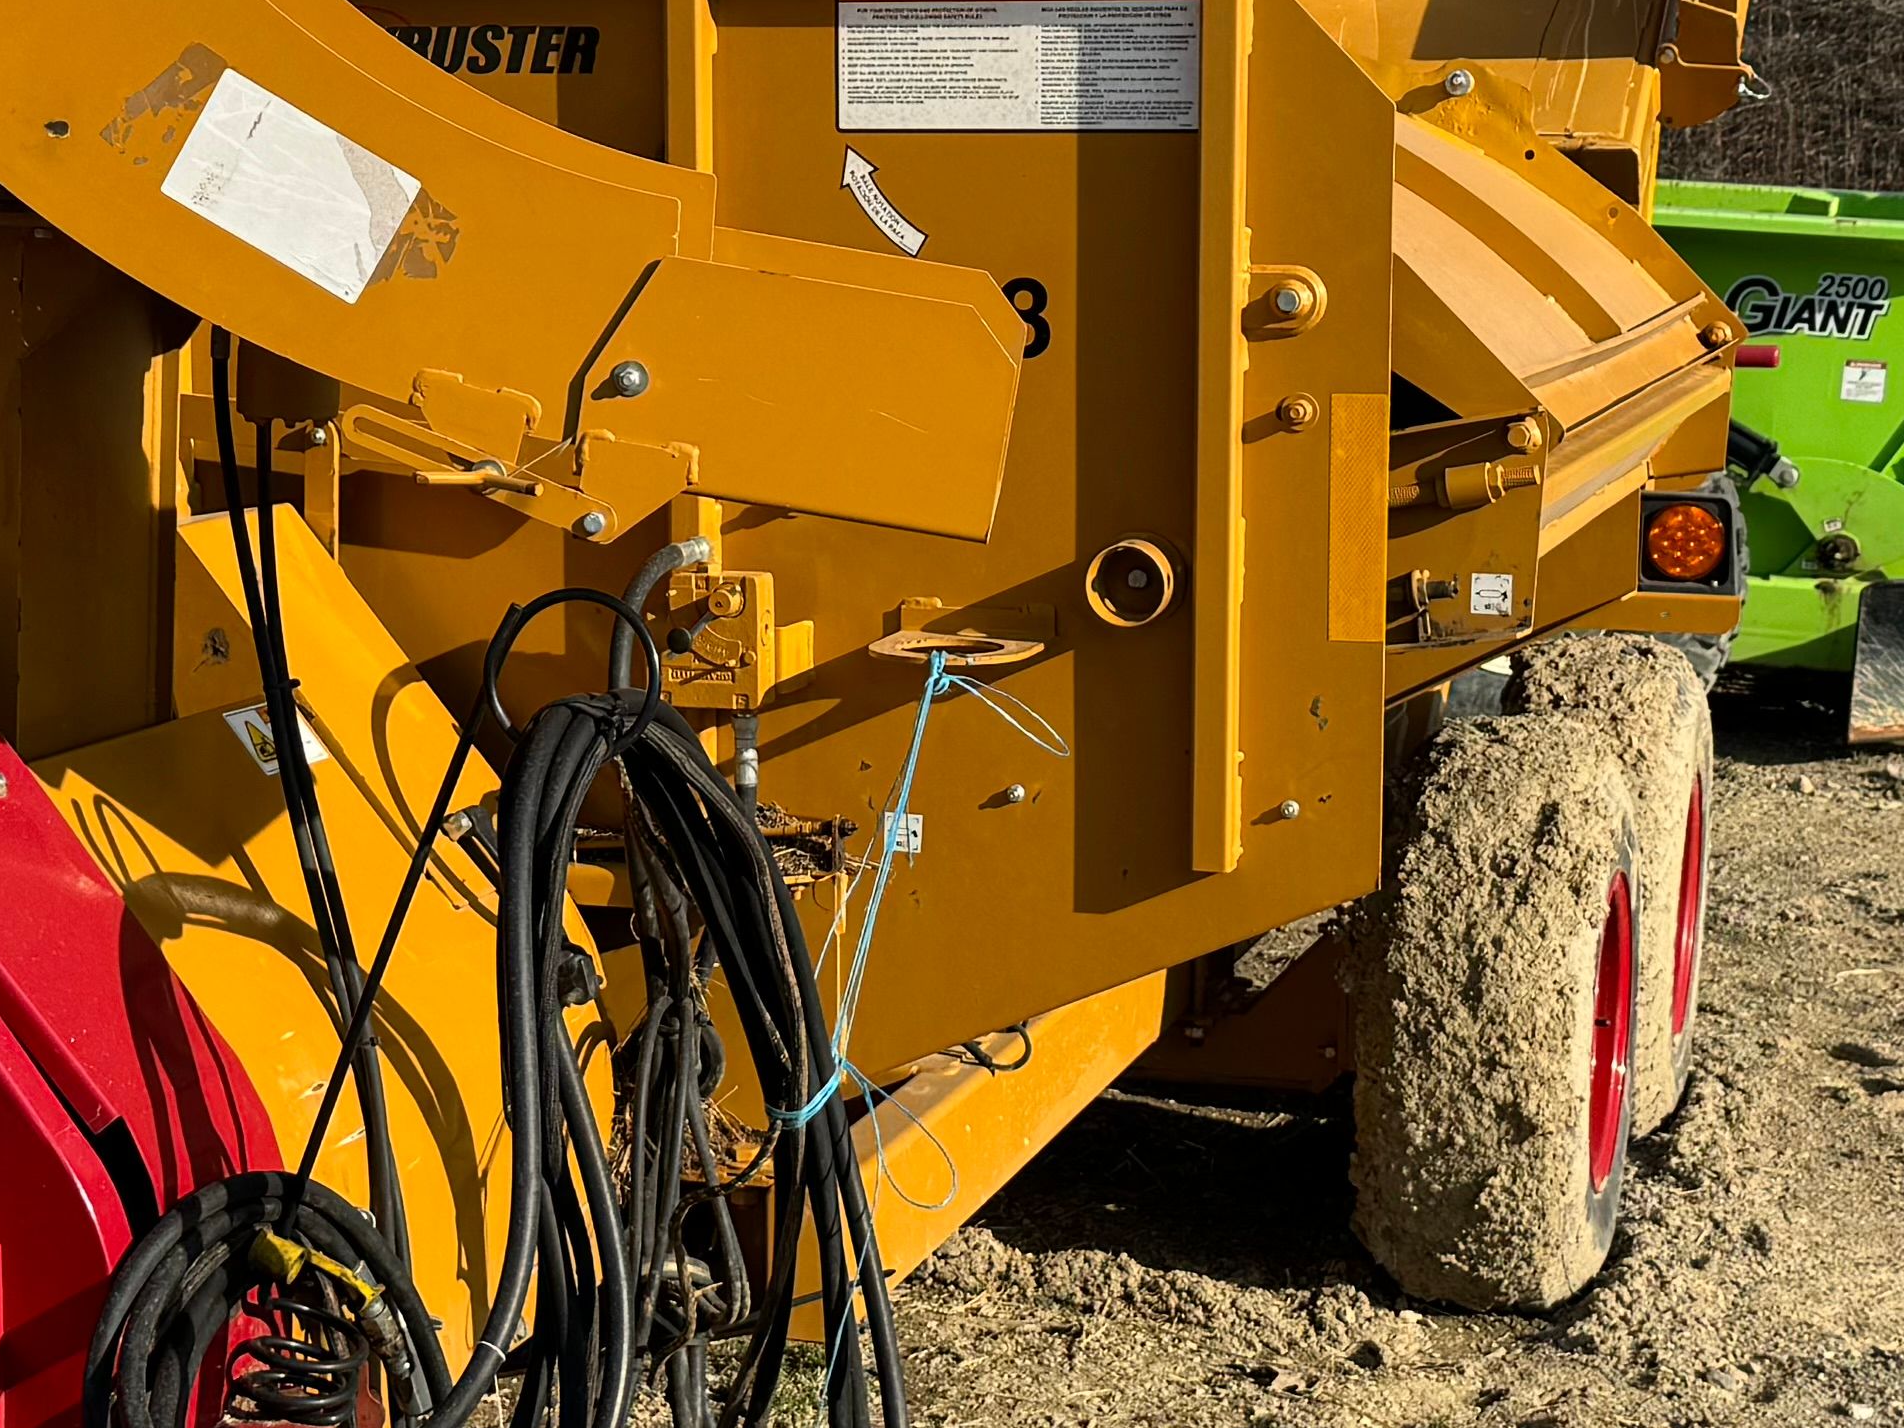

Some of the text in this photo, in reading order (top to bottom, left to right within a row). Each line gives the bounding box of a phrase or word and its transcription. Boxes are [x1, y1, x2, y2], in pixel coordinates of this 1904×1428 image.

[388, 25, 600, 74] BUSTER
[1726, 276, 1886, 336] GIANT
[1818, 275, 1886, 302] 2500
